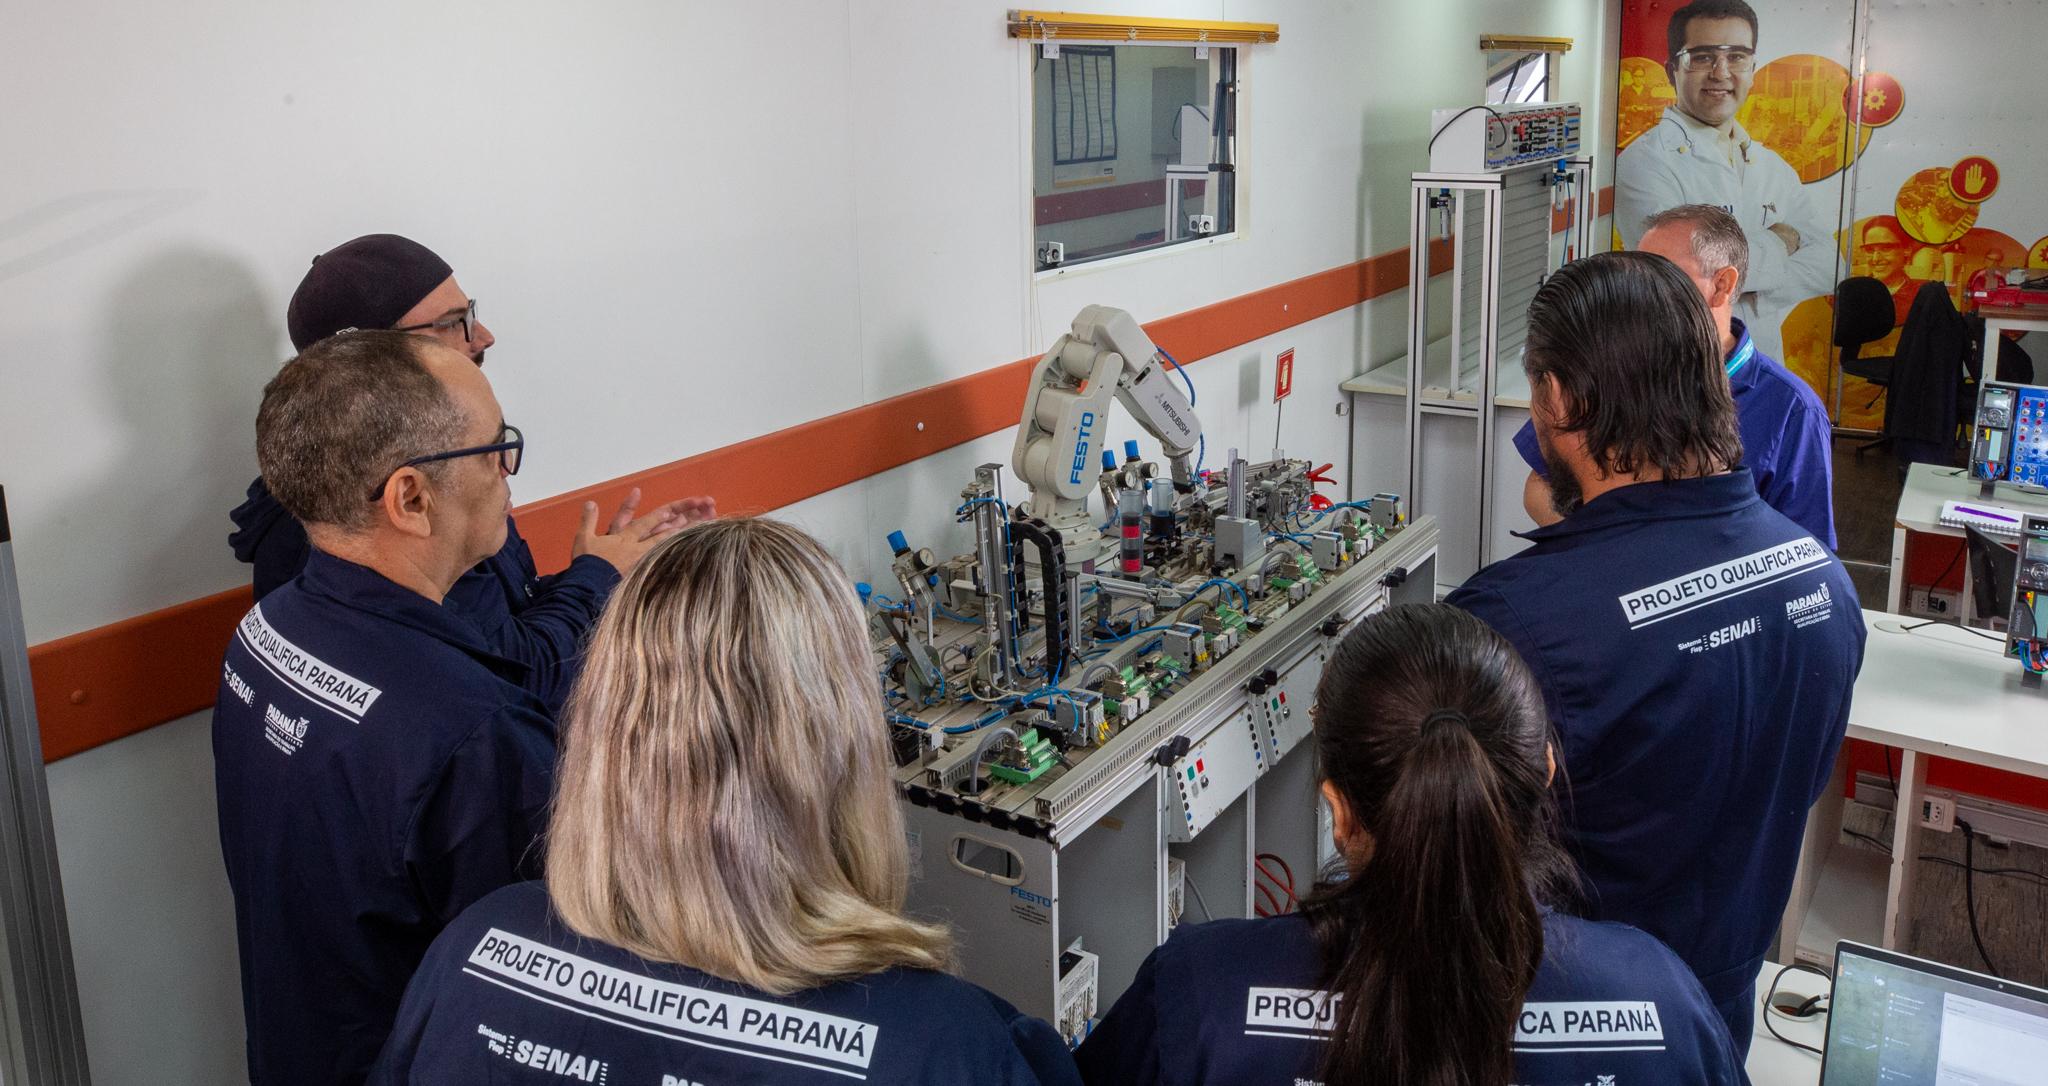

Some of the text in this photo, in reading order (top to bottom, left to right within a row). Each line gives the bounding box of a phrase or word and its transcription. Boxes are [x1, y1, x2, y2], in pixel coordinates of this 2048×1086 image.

[1161, 400, 1191, 437] MITSUBISHI
[1070, 412, 1094, 485] FESTO
[1627, 573, 1718, 616] PROJETO
[1720, 548, 1796, 584] QUALIFICA
[1786, 589, 1824, 614] PARANÁ
[1678, 638, 1702, 650] Sistema
[1709, 617, 1757, 649] SENAI
[259, 629, 307, 677] QUALIFICA
[305, 665, 373, 709] PARANÁ
[229, 672, 254, 705] SENAI
[267, 703, 297, 736] PARANÁ
[1011, 886, 1052, 908] FESTO
[478, 936, 866, 1058] PROJETO QUALIFICA PARANÁ
[478, 1023, 507, 1043] Sistema
[1564, 1003, 1658, 1033] PARANÁ
[513, 1039, 600, 1083] SENAI
